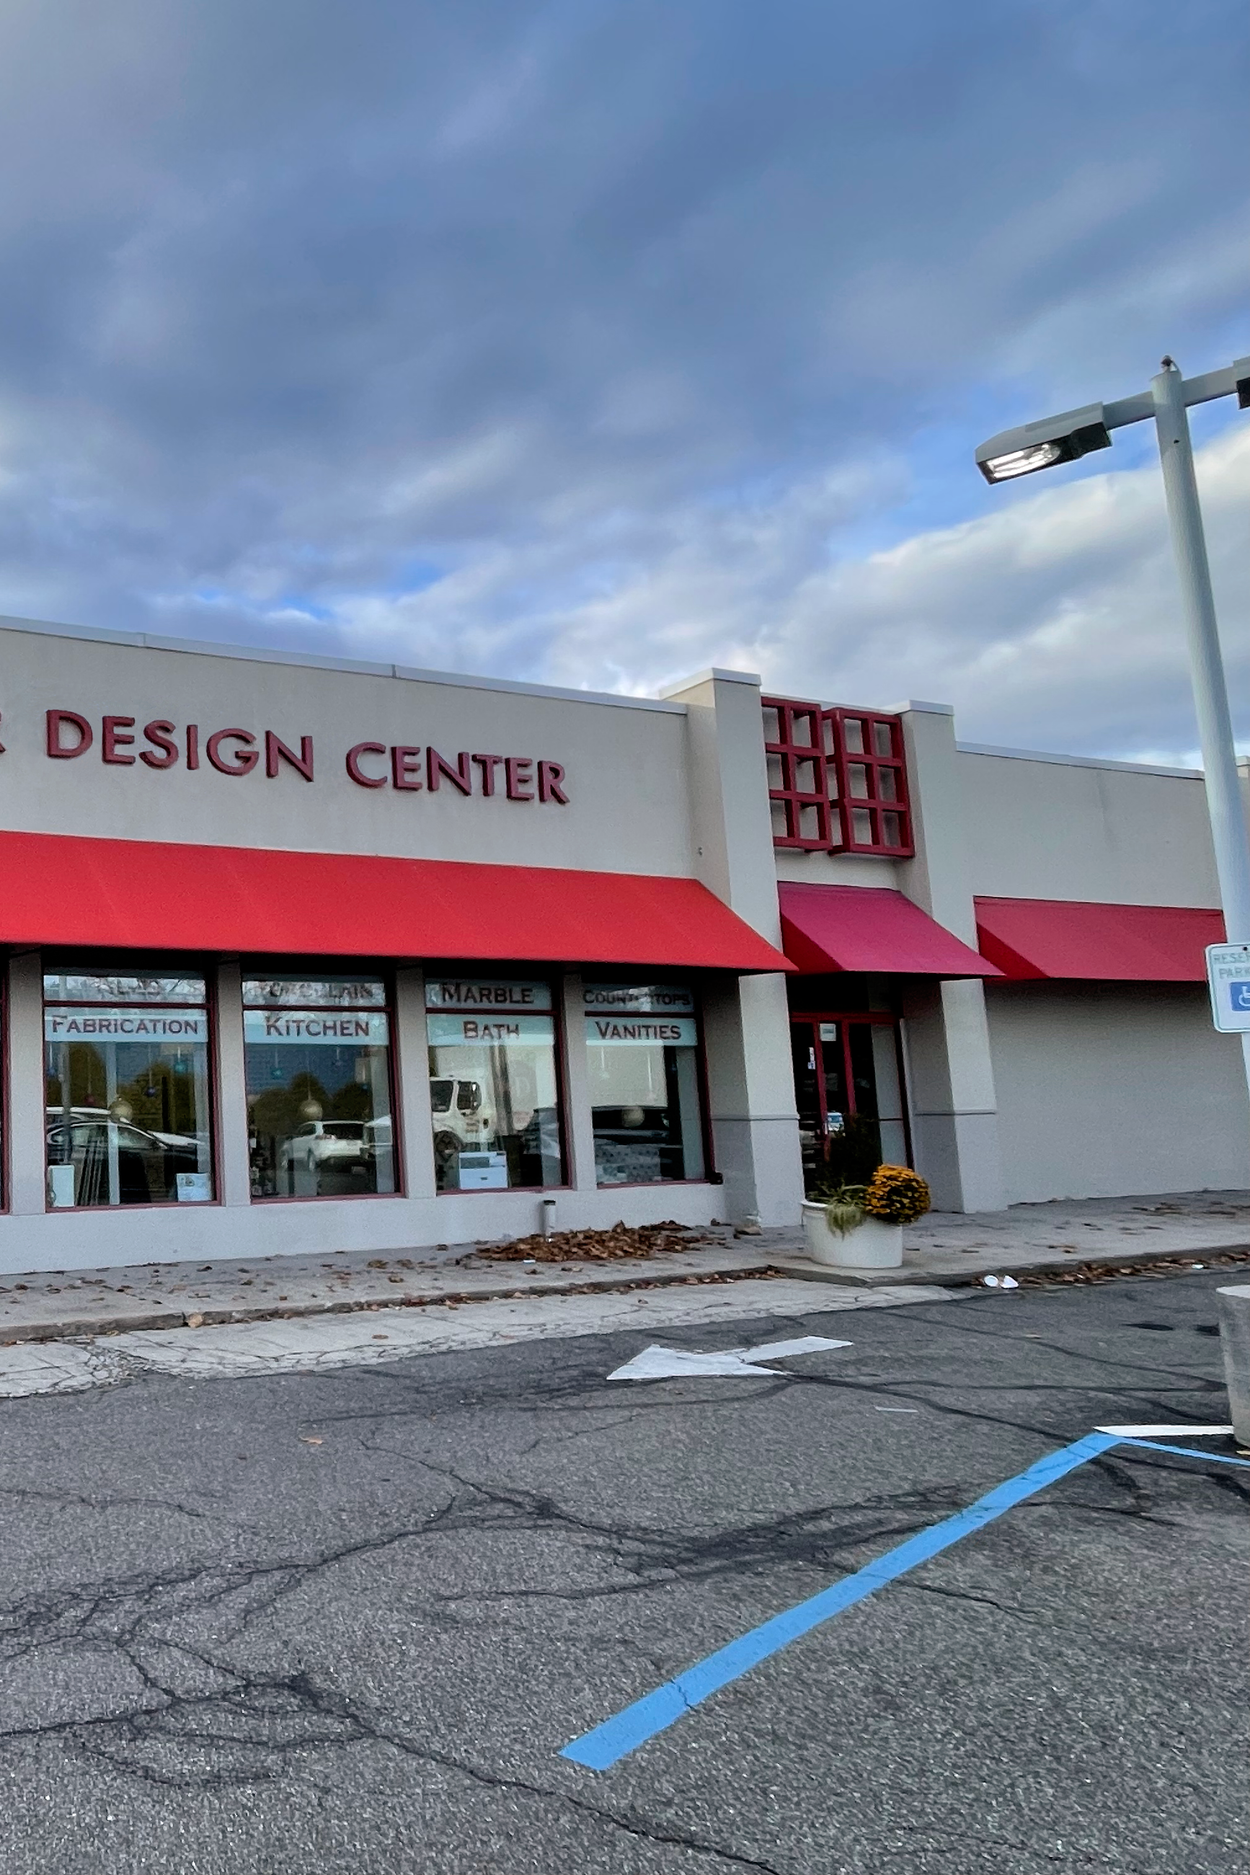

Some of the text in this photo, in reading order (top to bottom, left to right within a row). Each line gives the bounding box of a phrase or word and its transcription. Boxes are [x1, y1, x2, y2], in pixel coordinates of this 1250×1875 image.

[46, 708, 315, 783] DESIGN
[346, 741, 570, 805] CENTER
[441, 982, 535, 1004] MARBLE
[583, 989, 692, 1006] COUNTTOPS
[51, 1014, 199, 1035] FABRICATION
[265, 1016, 370, 1037] KITCHEN
[463, 1020, 520, 1040] BATH
[595, 1021, 682, 1040] VANITIES
